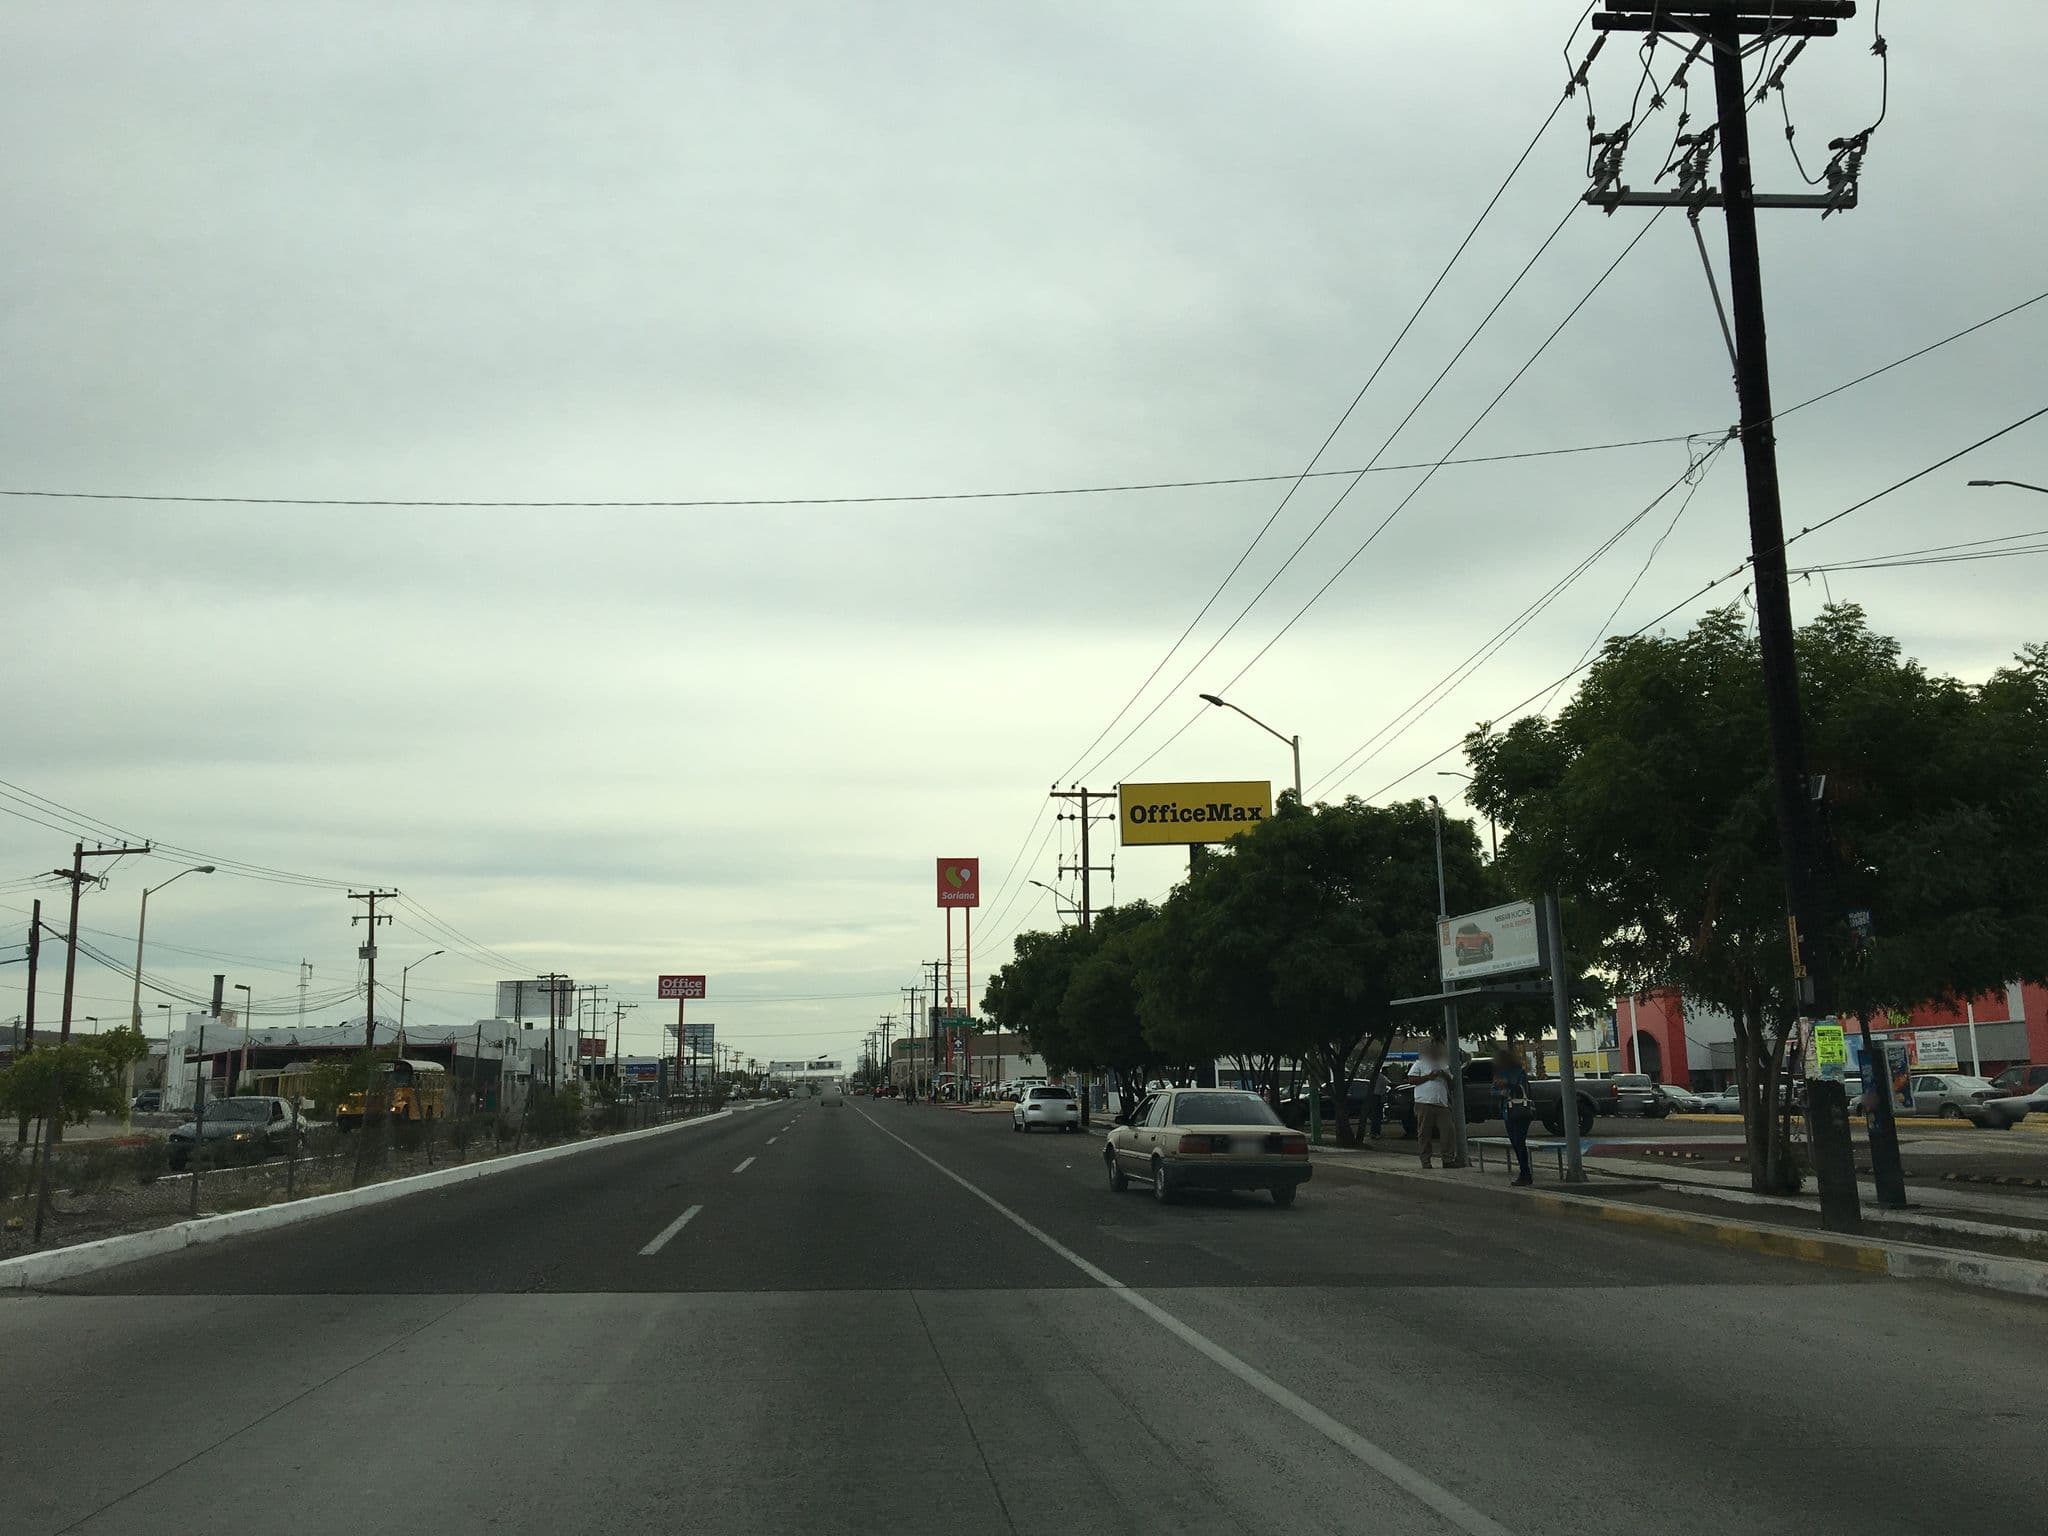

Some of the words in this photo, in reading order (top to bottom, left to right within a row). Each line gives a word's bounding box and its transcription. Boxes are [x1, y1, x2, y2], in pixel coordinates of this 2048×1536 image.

[1130, 803, 1263, 824] OfficeMax
[942, 891, 975, 900] Soriana
[662, 978, 702, 988] Office
